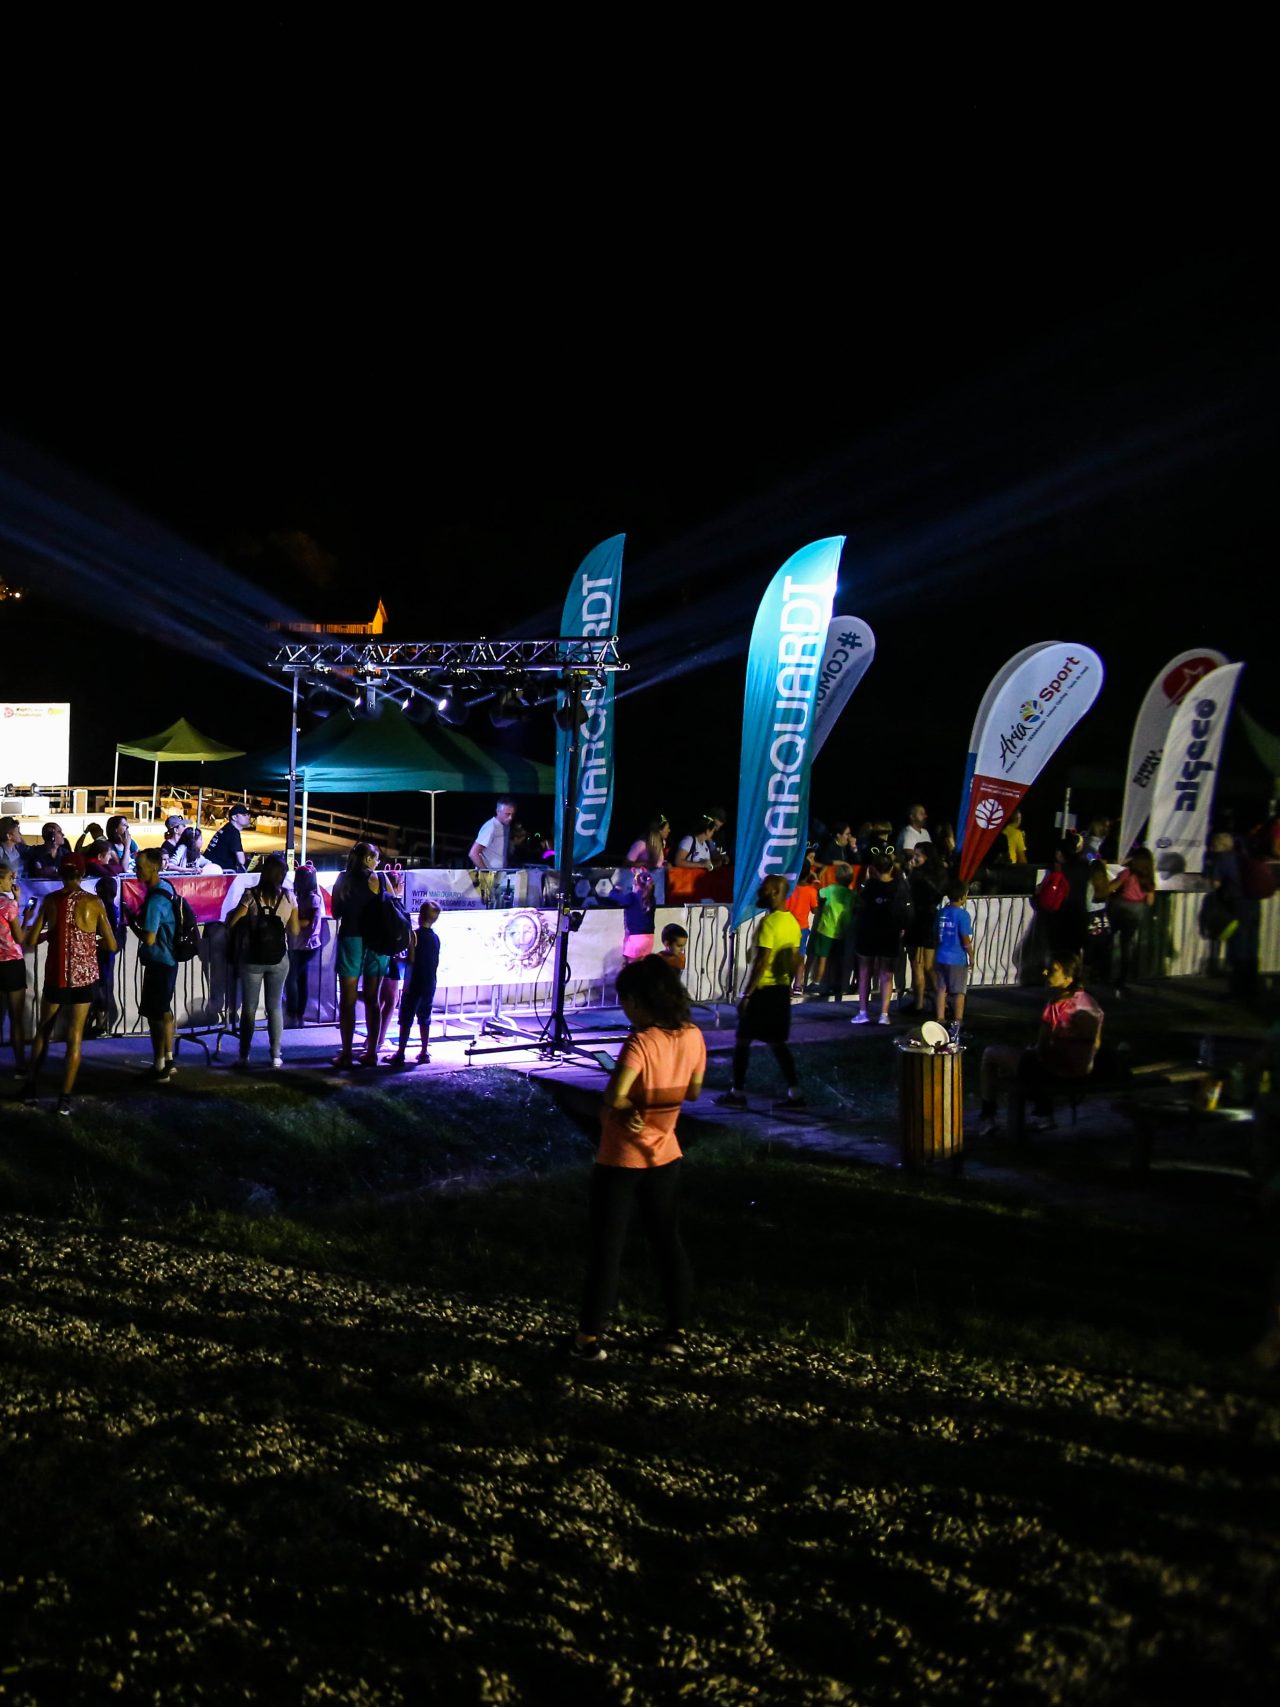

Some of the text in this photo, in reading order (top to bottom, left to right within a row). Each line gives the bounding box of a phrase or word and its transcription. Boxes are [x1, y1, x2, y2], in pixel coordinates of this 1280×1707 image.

[758, 576, 825, 881] MARQUARDT
[1000, 722, 1033, 769] Aria
[1039, 656, 1080, 702] Sport
[1175, 698, 1217, 812] algeco
